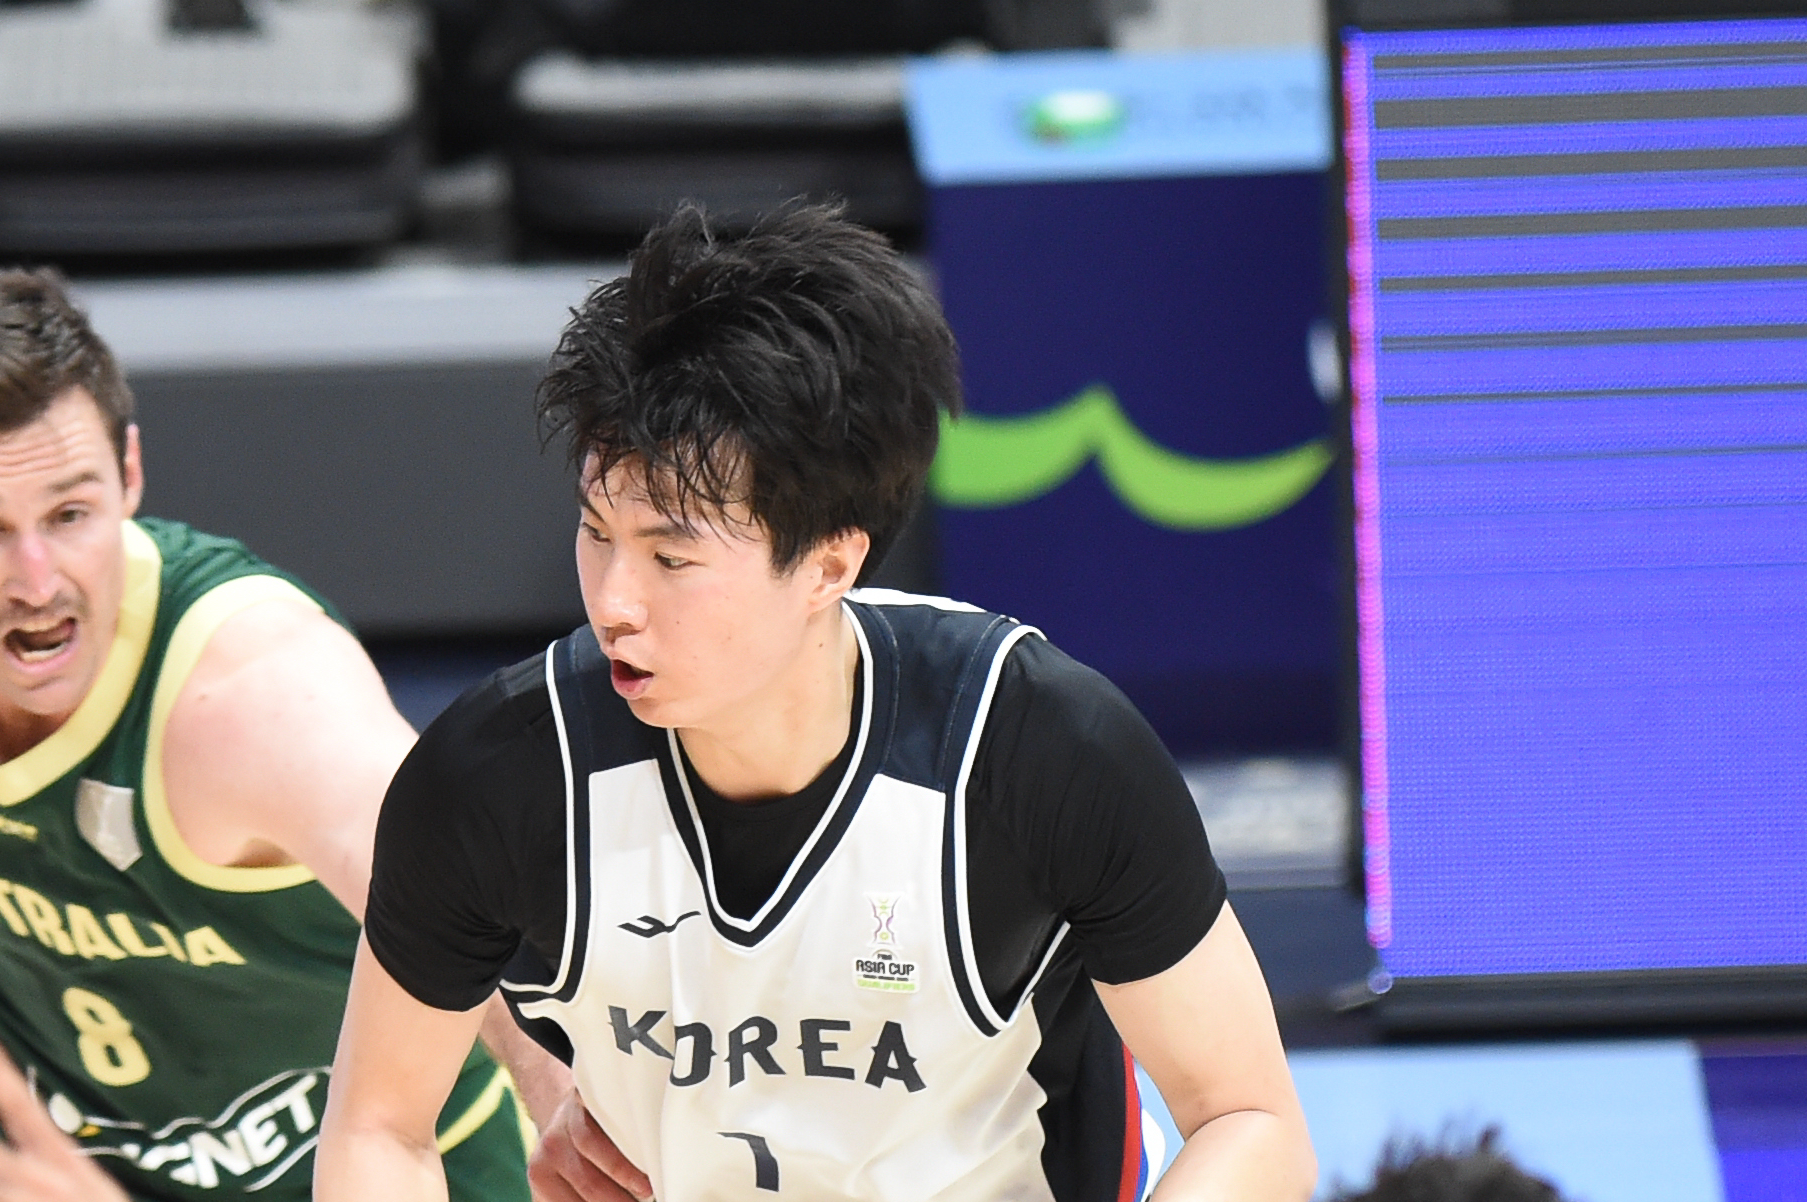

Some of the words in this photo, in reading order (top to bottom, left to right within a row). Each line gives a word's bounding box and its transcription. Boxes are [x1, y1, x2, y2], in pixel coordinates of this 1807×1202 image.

[855, 959, 886, 974] ASIA
[888, 962, 915, 976] CUP
[63, 987, 151, 1087] 8
[607, 1004, 928, 1094] KOREA
